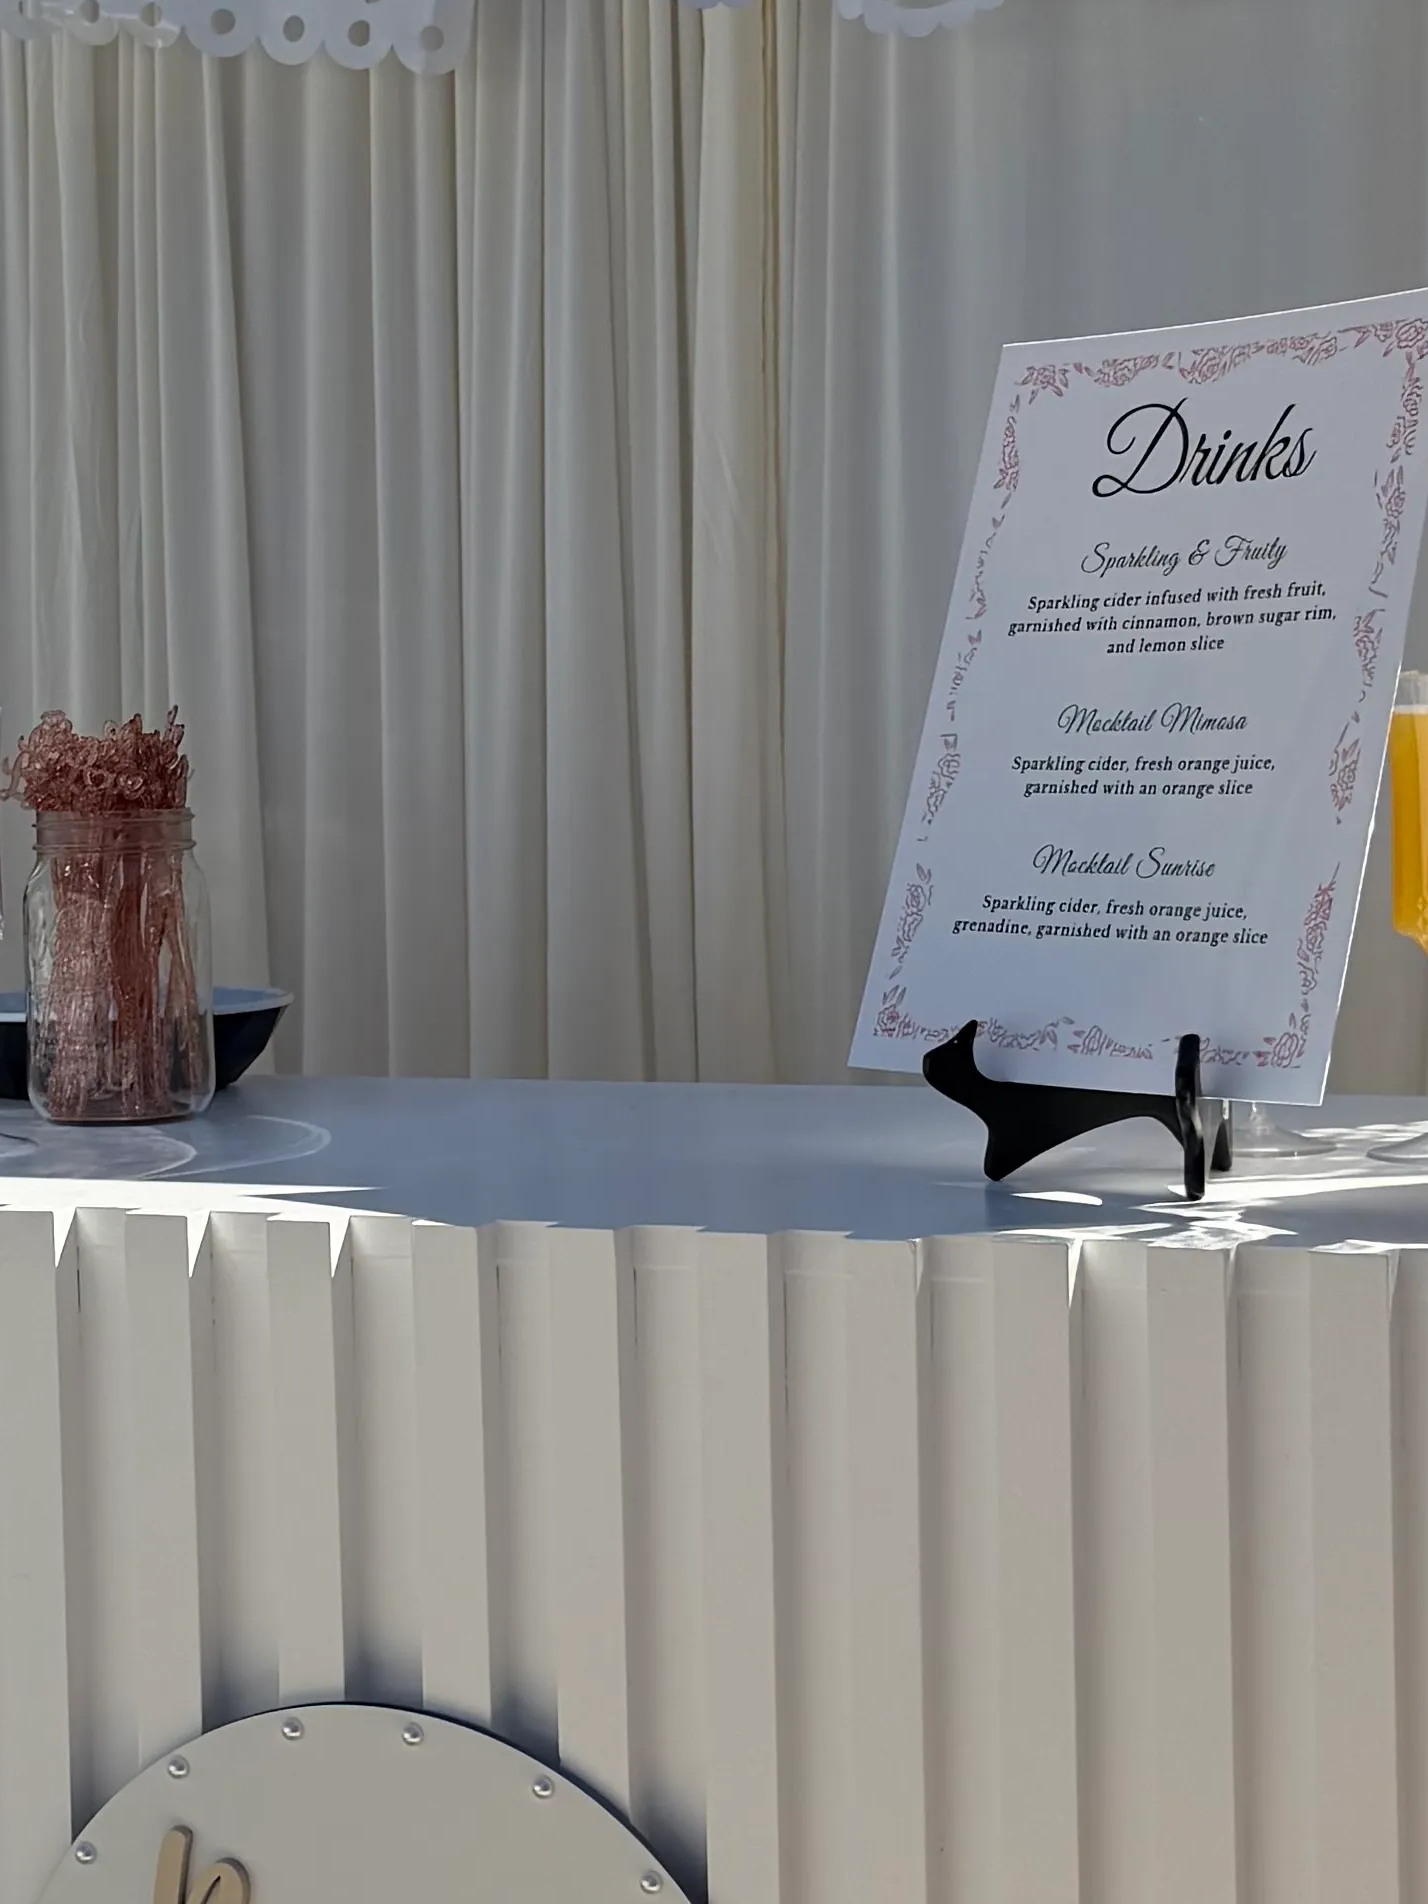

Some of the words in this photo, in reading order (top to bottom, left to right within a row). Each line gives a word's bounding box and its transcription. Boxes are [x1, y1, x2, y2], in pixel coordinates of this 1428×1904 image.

[1091, 396, 1318, 498] Drinks
[1080, 541, 1181, 579] Sparkling
[1187, 538, 1211, 566] &
[1213, 534, 1288, 570] Fruity
[1027, 593, 1100, 614] Sparkling
[1103, 591, 1143, 608] cider
[1144, 587, 1203, 606] infused
[1206, 585, 1239, 603] with
[1243, 582, 1282, 601] fresh
[1286, 579, 1326, 598] fruit,
[1007, 616, 1083, 637] garnished
[1086, 615, 1118, 632] with
[1205, 611, 1255, 627] brown
[1258, 610, 1302, 627] sugar
[1304, 604, 1337, 621] rim,
[1106, 638, 1136, 654] and
[1138, 637, 1186, 653] lemon
[1189, 634, 1225, 651] slice
[1057, 703, 1158, 736] Mocktail
[1160, 702, 1248, 736] Mimosa
[1011, 755, 1087, 776] Sparkling
[1087, 755, 1130, 773] cider,
[1134, 755, 1173, 772] fresh
[1177, 758, 1231, 775] orange
[1230, 753, 1275, 775] juice,
[1023, 778, 1100, 799] garnished
[1102, 779, 1135, 796] with
[1138, 784, 1157, 796] an
[1161, 783, 1215, 800] orange
[1217, 778, 1254, 795] slice
[1032, 843, 1134, 877] Mocktail
[1135, 846, 1216, 879] Sunrise
[981, 894, 1057, 916] Sparkling
[1058, 897, 1101, 916] cider,
[1105, 898, 1145, 916] fresh
[1148, 904, 1202, 922] orange
[1201, 901, 1247, 922] juice,
[951, 917, 1032, 936] grenadine,
[1035, 922, 1112, 940] garnished
[1115, 923, 1149, 941] with
[1152, 929, 1171, 942] an
[1175, 930, 1230, 948] orange
[1232, 927, 1269, 945] slice
